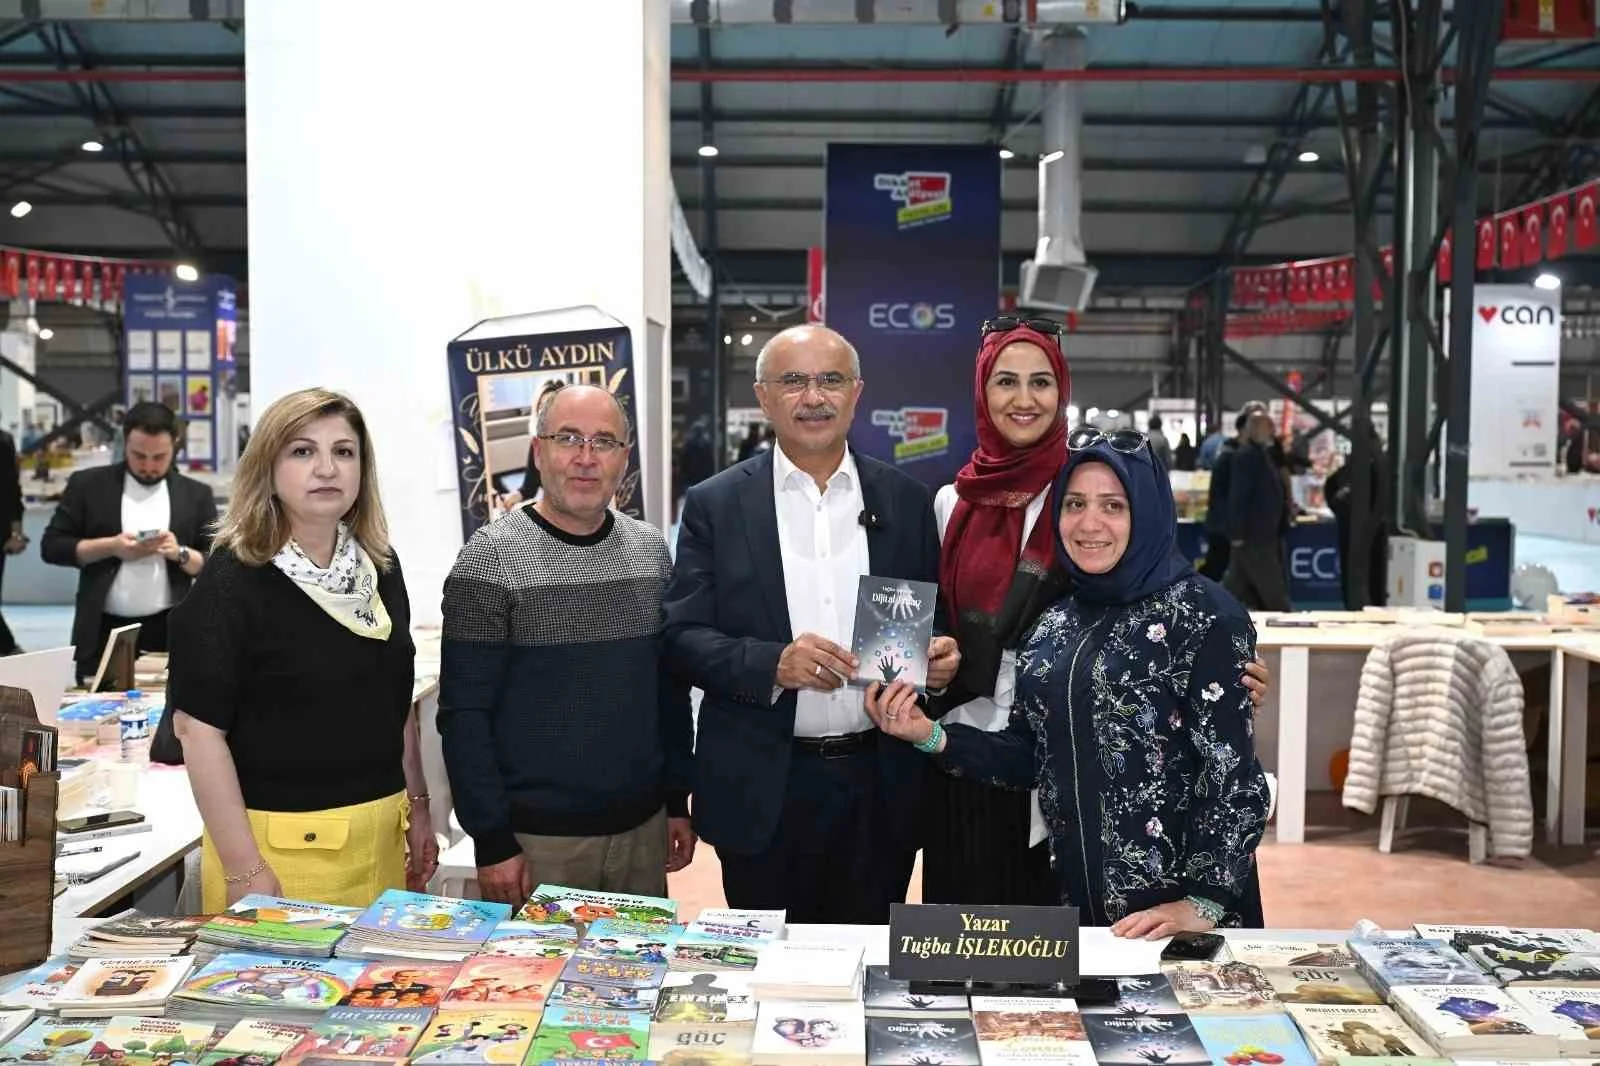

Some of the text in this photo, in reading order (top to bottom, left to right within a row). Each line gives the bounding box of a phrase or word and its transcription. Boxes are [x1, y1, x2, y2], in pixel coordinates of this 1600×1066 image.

[869, 303, 955, 328] ECOS
[1501, 305, 1554, 325] can
[465, 341, 615, 373] ÜLKÜ AYDIN
[1291, 546, 1340, 579] EC
[960, 913, 1010, 932] Yazar
[900, 933, 1070, 960] Tuğba İŞLEKOĞLU
[887, 1025, 921, 1033] Dijital
